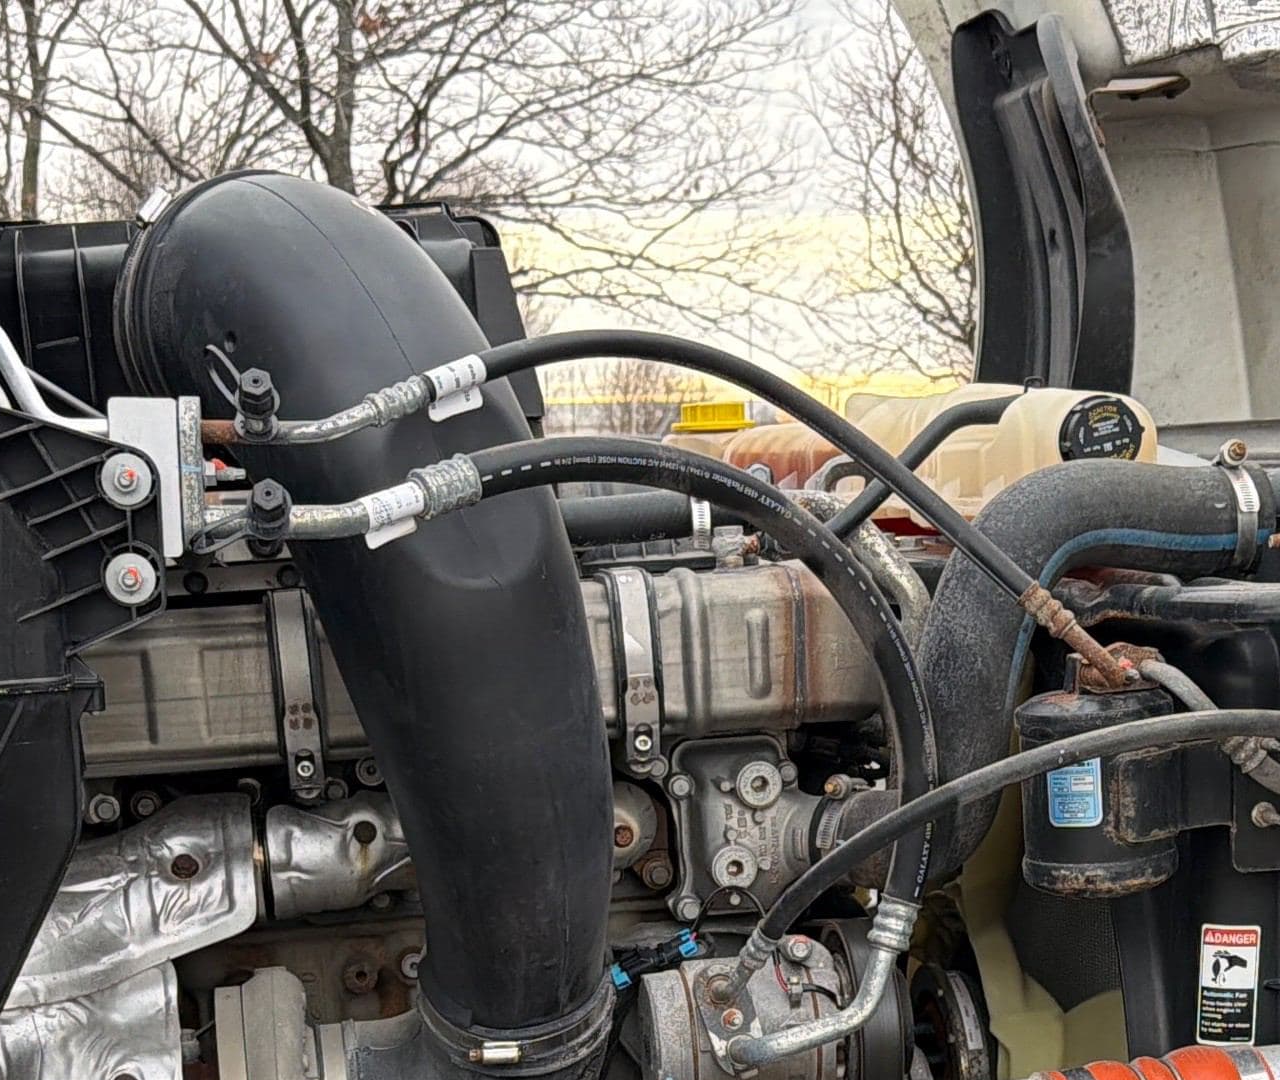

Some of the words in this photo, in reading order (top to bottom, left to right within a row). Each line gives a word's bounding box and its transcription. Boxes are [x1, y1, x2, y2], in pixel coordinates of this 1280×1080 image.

[598, 456, 617, 465] HOSE
[618, 457, 647, 466] SUCTION
[758, 494, 792, 519] GALAXY
[917, 841, 931, 884] GALAXY
[1214, 932, 1257, 945] DANGER
